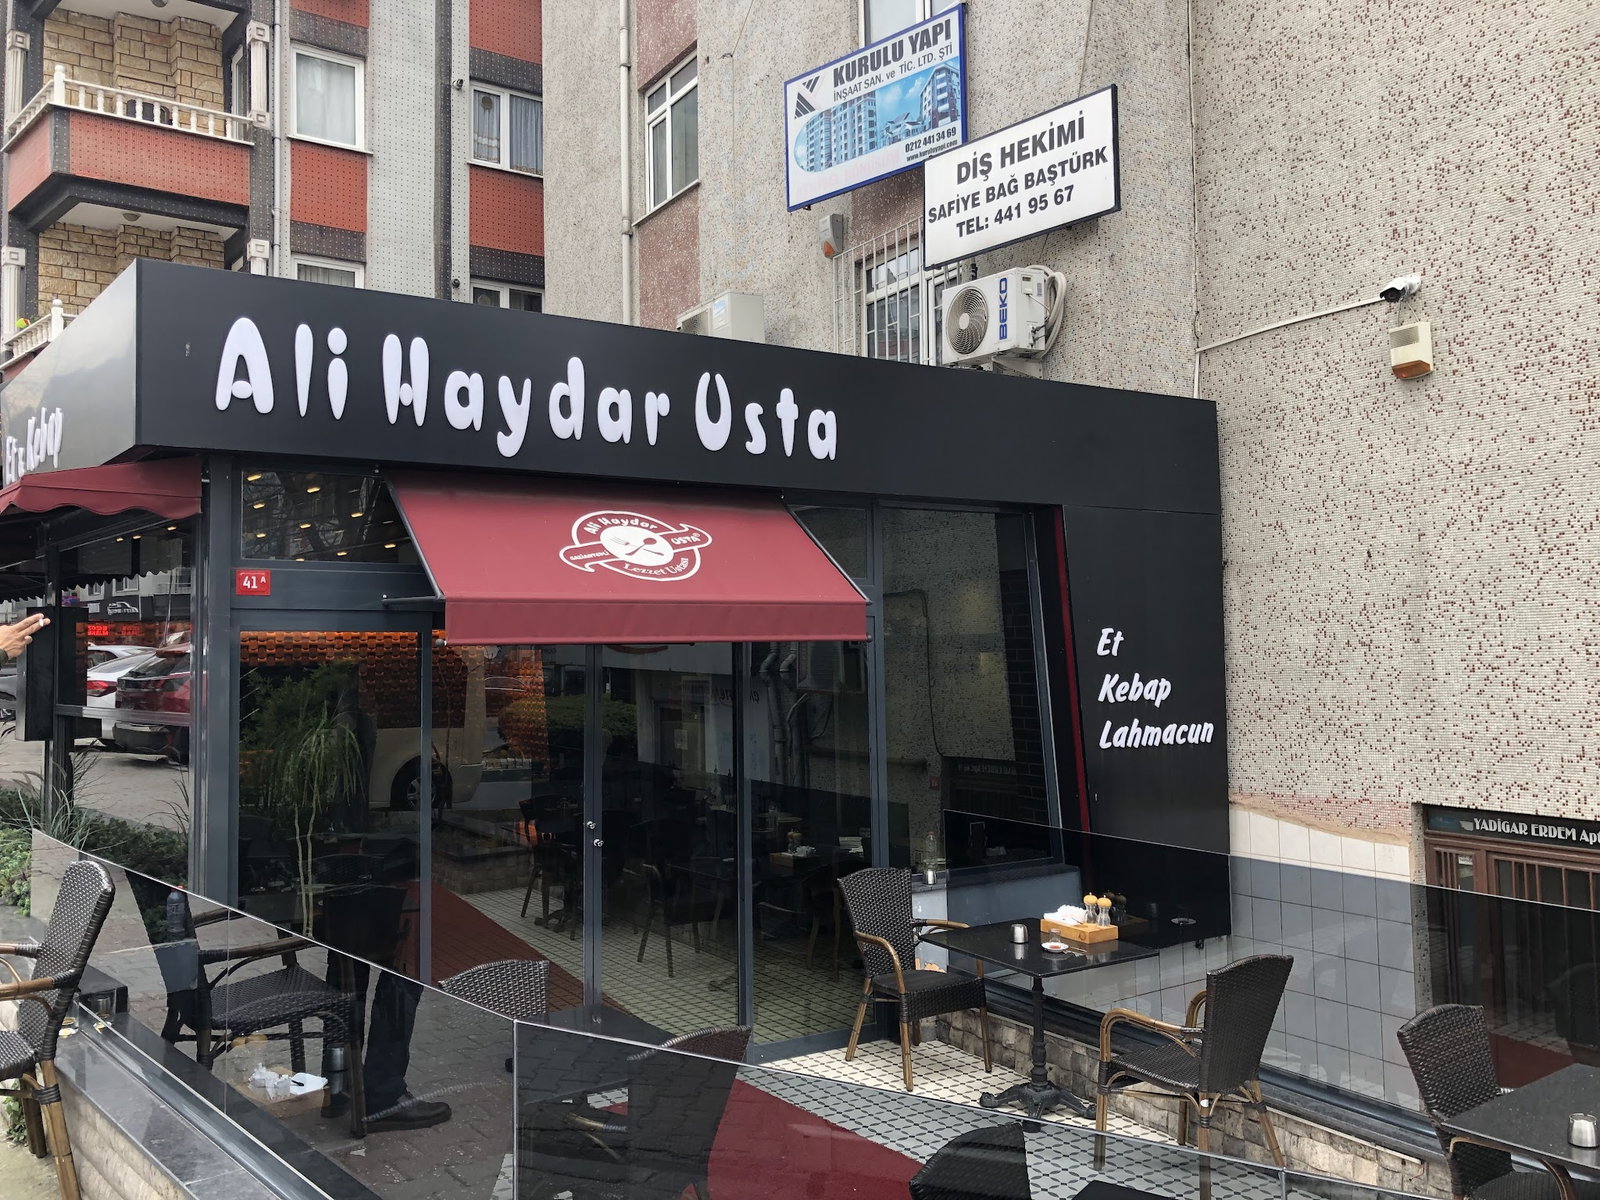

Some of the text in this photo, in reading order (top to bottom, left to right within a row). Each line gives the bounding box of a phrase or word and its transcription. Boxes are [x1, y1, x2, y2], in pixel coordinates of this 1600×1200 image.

[833, 18, 952, 88] KURULU YAPI
[833, 42, 953, 102] İNŞAAT SAN. ve TİC. LTD. ŞTİ
[905, 126, 957, 153] 0212 441 34 69
[957, 110, 1085, 185] DİŞ HEKİMİ
[928, 145, 1109, 224] SAFİYE BAĞ BAŞTÜRK
[956, 184, 1075, 238] TEL: 441 95 67
[999, 276, 1008, 341] BEKO
[215, 317, 838, 462] Ali Haydar Usta
[597, 517, 658, 531] Haydar
[242, 575, 267, 589] 41 A
[1096, 627, 1124, 656] Et
[1097, 672, 1172, 708] Kebap
[1099, 718, 1214, 749] Lahmacun
[1473, 818, 1528, 835] YADİGAR
[1531, 823, 1577, 841] ERDEM
